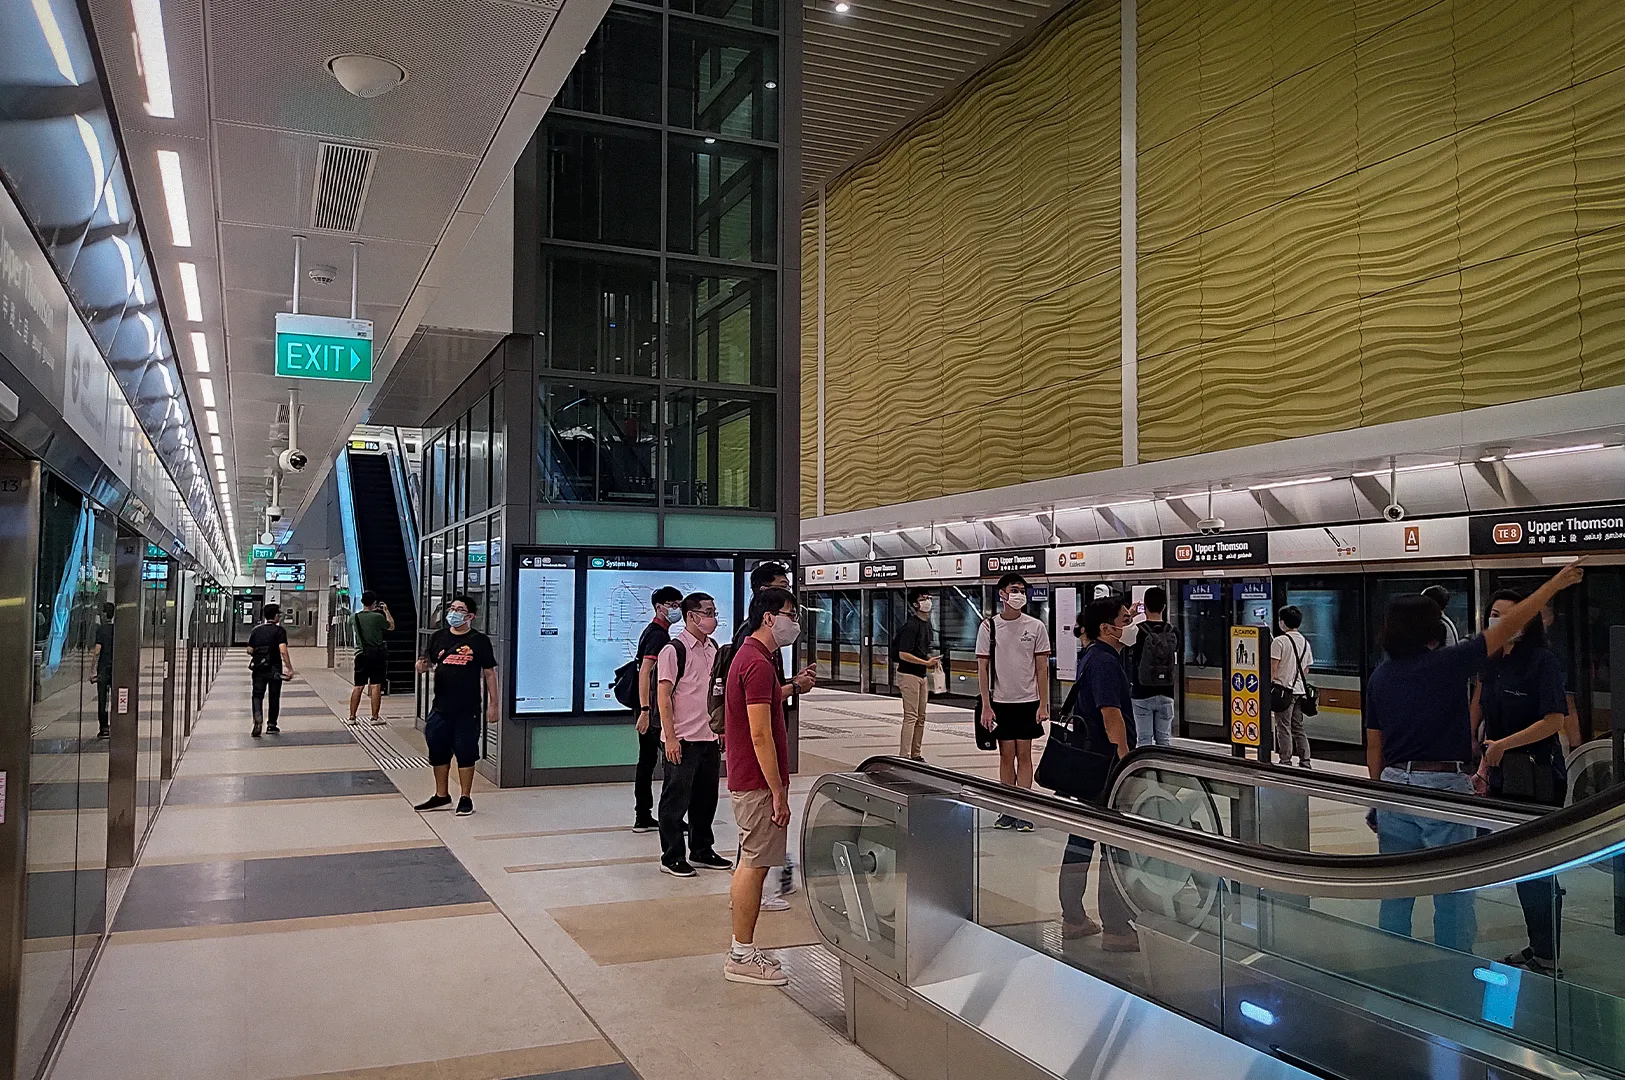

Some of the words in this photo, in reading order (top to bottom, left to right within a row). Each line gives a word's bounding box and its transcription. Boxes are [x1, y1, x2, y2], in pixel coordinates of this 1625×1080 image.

[287, 342, 345, 372] EXIT
[1, 480, 19, 492] 13
[1527, 520, 1563, 535] Upper
[1566, 517, 1624, 530] Thomson
[1407, 530, 1417, 544] A
[1498, 528, 1509, 539] TE
[1511, 528, 1517, 538] 8
[125, 546, 134, 554] 12
[255, 549, 269, 558] EXIT
[1178, 549, 1185, 557] TE
[1194, 543, 1216, 555] Upper
[1216, 541, 1249, 552] Thomson
[606, 560, 626, 569] System
[626, 560, 639, 569] Map
